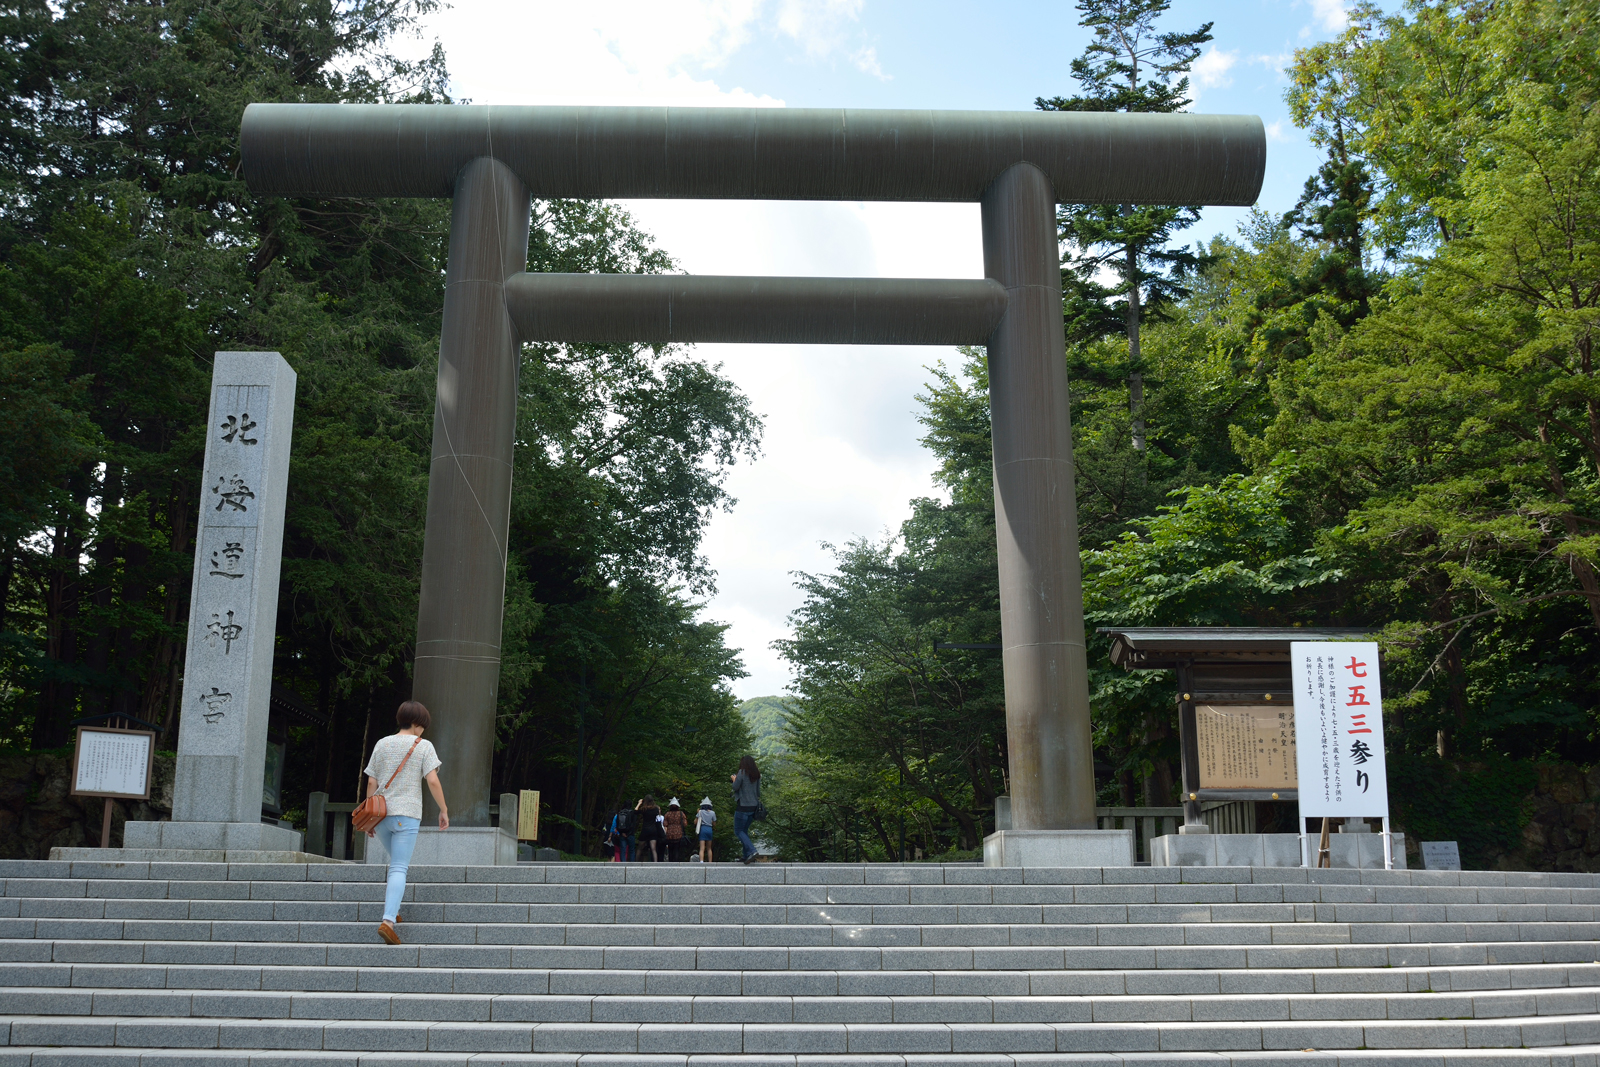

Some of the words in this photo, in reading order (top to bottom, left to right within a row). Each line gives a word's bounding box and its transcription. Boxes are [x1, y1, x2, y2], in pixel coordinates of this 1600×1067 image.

[199, 413, 259, 725] 北海道神宮
[1306, 656, 1315, 699] お祈りします。
[1344, 656, 1373, 794] 七五三参り
